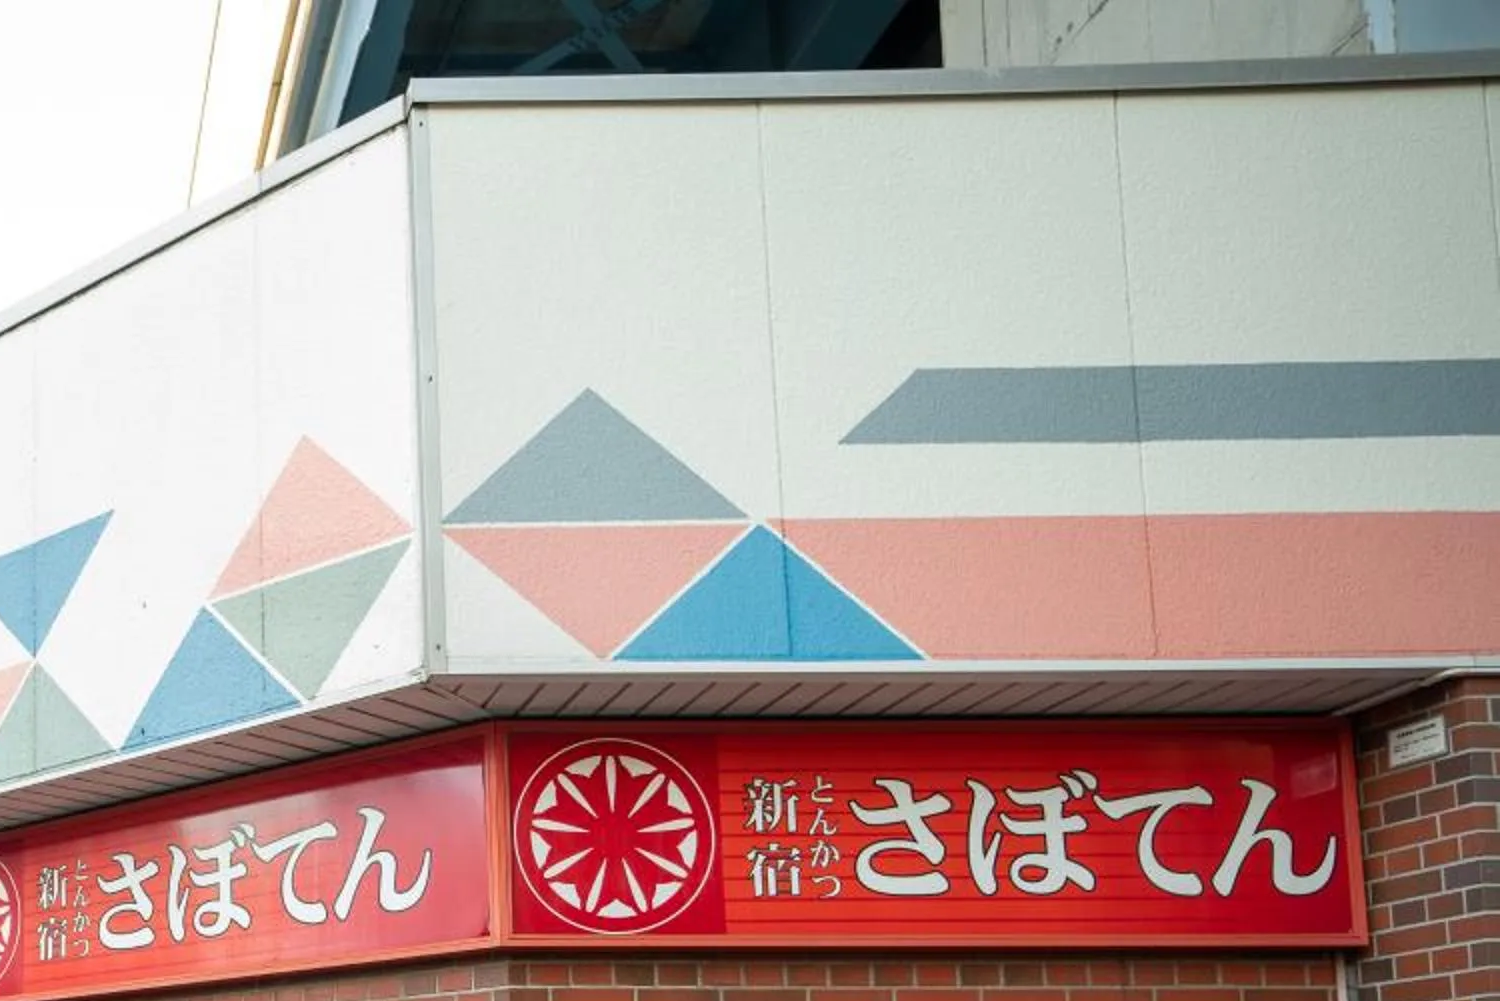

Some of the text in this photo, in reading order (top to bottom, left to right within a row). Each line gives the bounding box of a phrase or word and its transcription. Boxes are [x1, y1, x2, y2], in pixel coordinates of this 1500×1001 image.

[97, 806, 432, 949] さぼてん
[743, 776, 801, 897] 新宿
[808, 774, 841, 899] とんかつ
[847, 768, 1338, 897] さぼてん
[36, 864, 68, 961] 新宿
[72, 858, 91, 958] とんかつ
